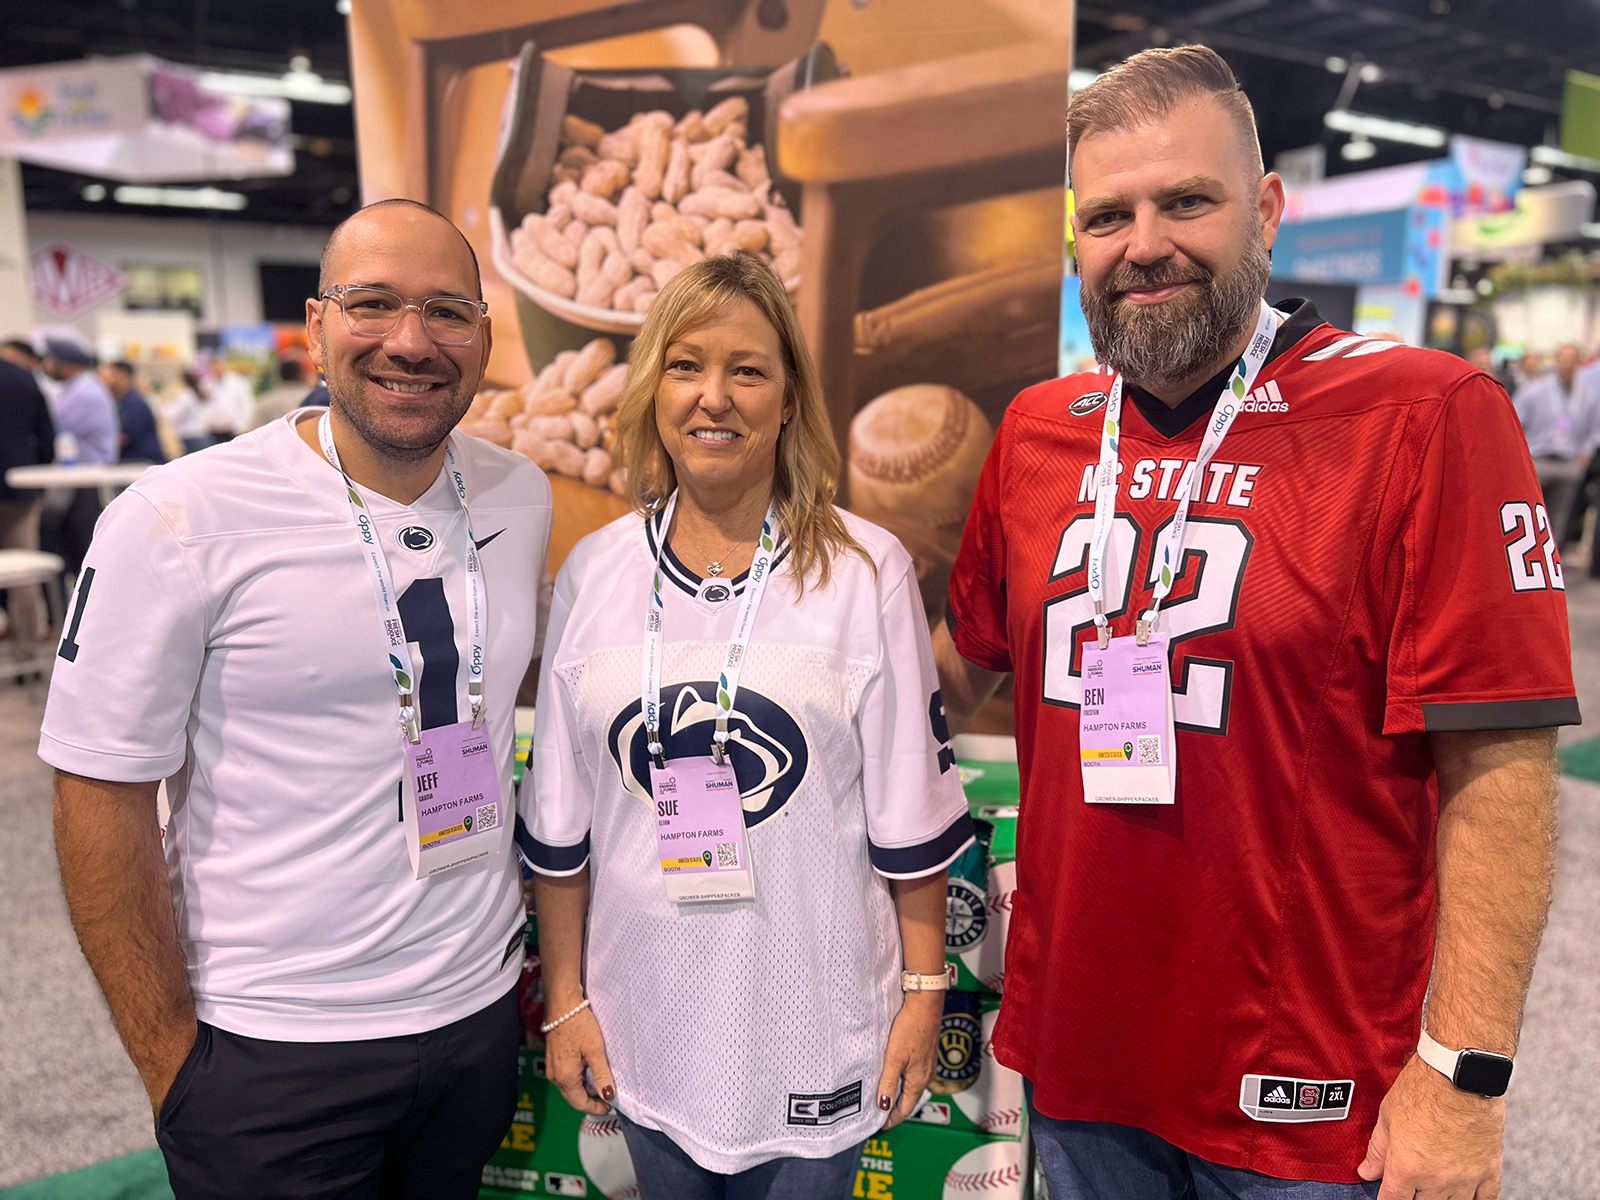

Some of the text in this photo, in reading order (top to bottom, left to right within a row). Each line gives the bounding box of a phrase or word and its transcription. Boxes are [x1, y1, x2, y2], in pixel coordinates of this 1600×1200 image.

[1249, 334, 1265, 357] PRODUCE
[1259, 337, 1270, 353] FRESH
[1129, 458, 1264, 507] STATE
[1498, 500, 1565, 593] 22
[370, 552, 380, 569] Expect
[378, 578, 386, 593] world
[58, 566, 96, 663] 1
[391, 619, 400, 638] FRESH
[1041, 511, 1255, 737] 22
[386, 620, 398, 647] PRODUCE
[1132, 664, 1161, 673] SHUMAN
[1085, 688, 1104, 706] BEN
[1083, 722, 1146, 732] HAMPTON FARMS
[462, 744, 488, 755] SHUMAN
[417, 772, 438, 793] JEFF
[706, 781, 733, 789] SHUMAN
[421, 793, 484, 817] HAMPTON FARMS
[658, 800, 679, 817] SUE
[439, 824, 463, 837] UNITED STATES
[661, 829, 724, 840] HAMPTON FARMS
[422, 840, 440, 850] BOOTH
[820, 1093, 860, 1111] COLOSSEUM
[1264, 1096, 1291, 1104] adidas
[1329, 1091, 1344, 1101] 2XL
[861, 1156, 893, 1172] THE
